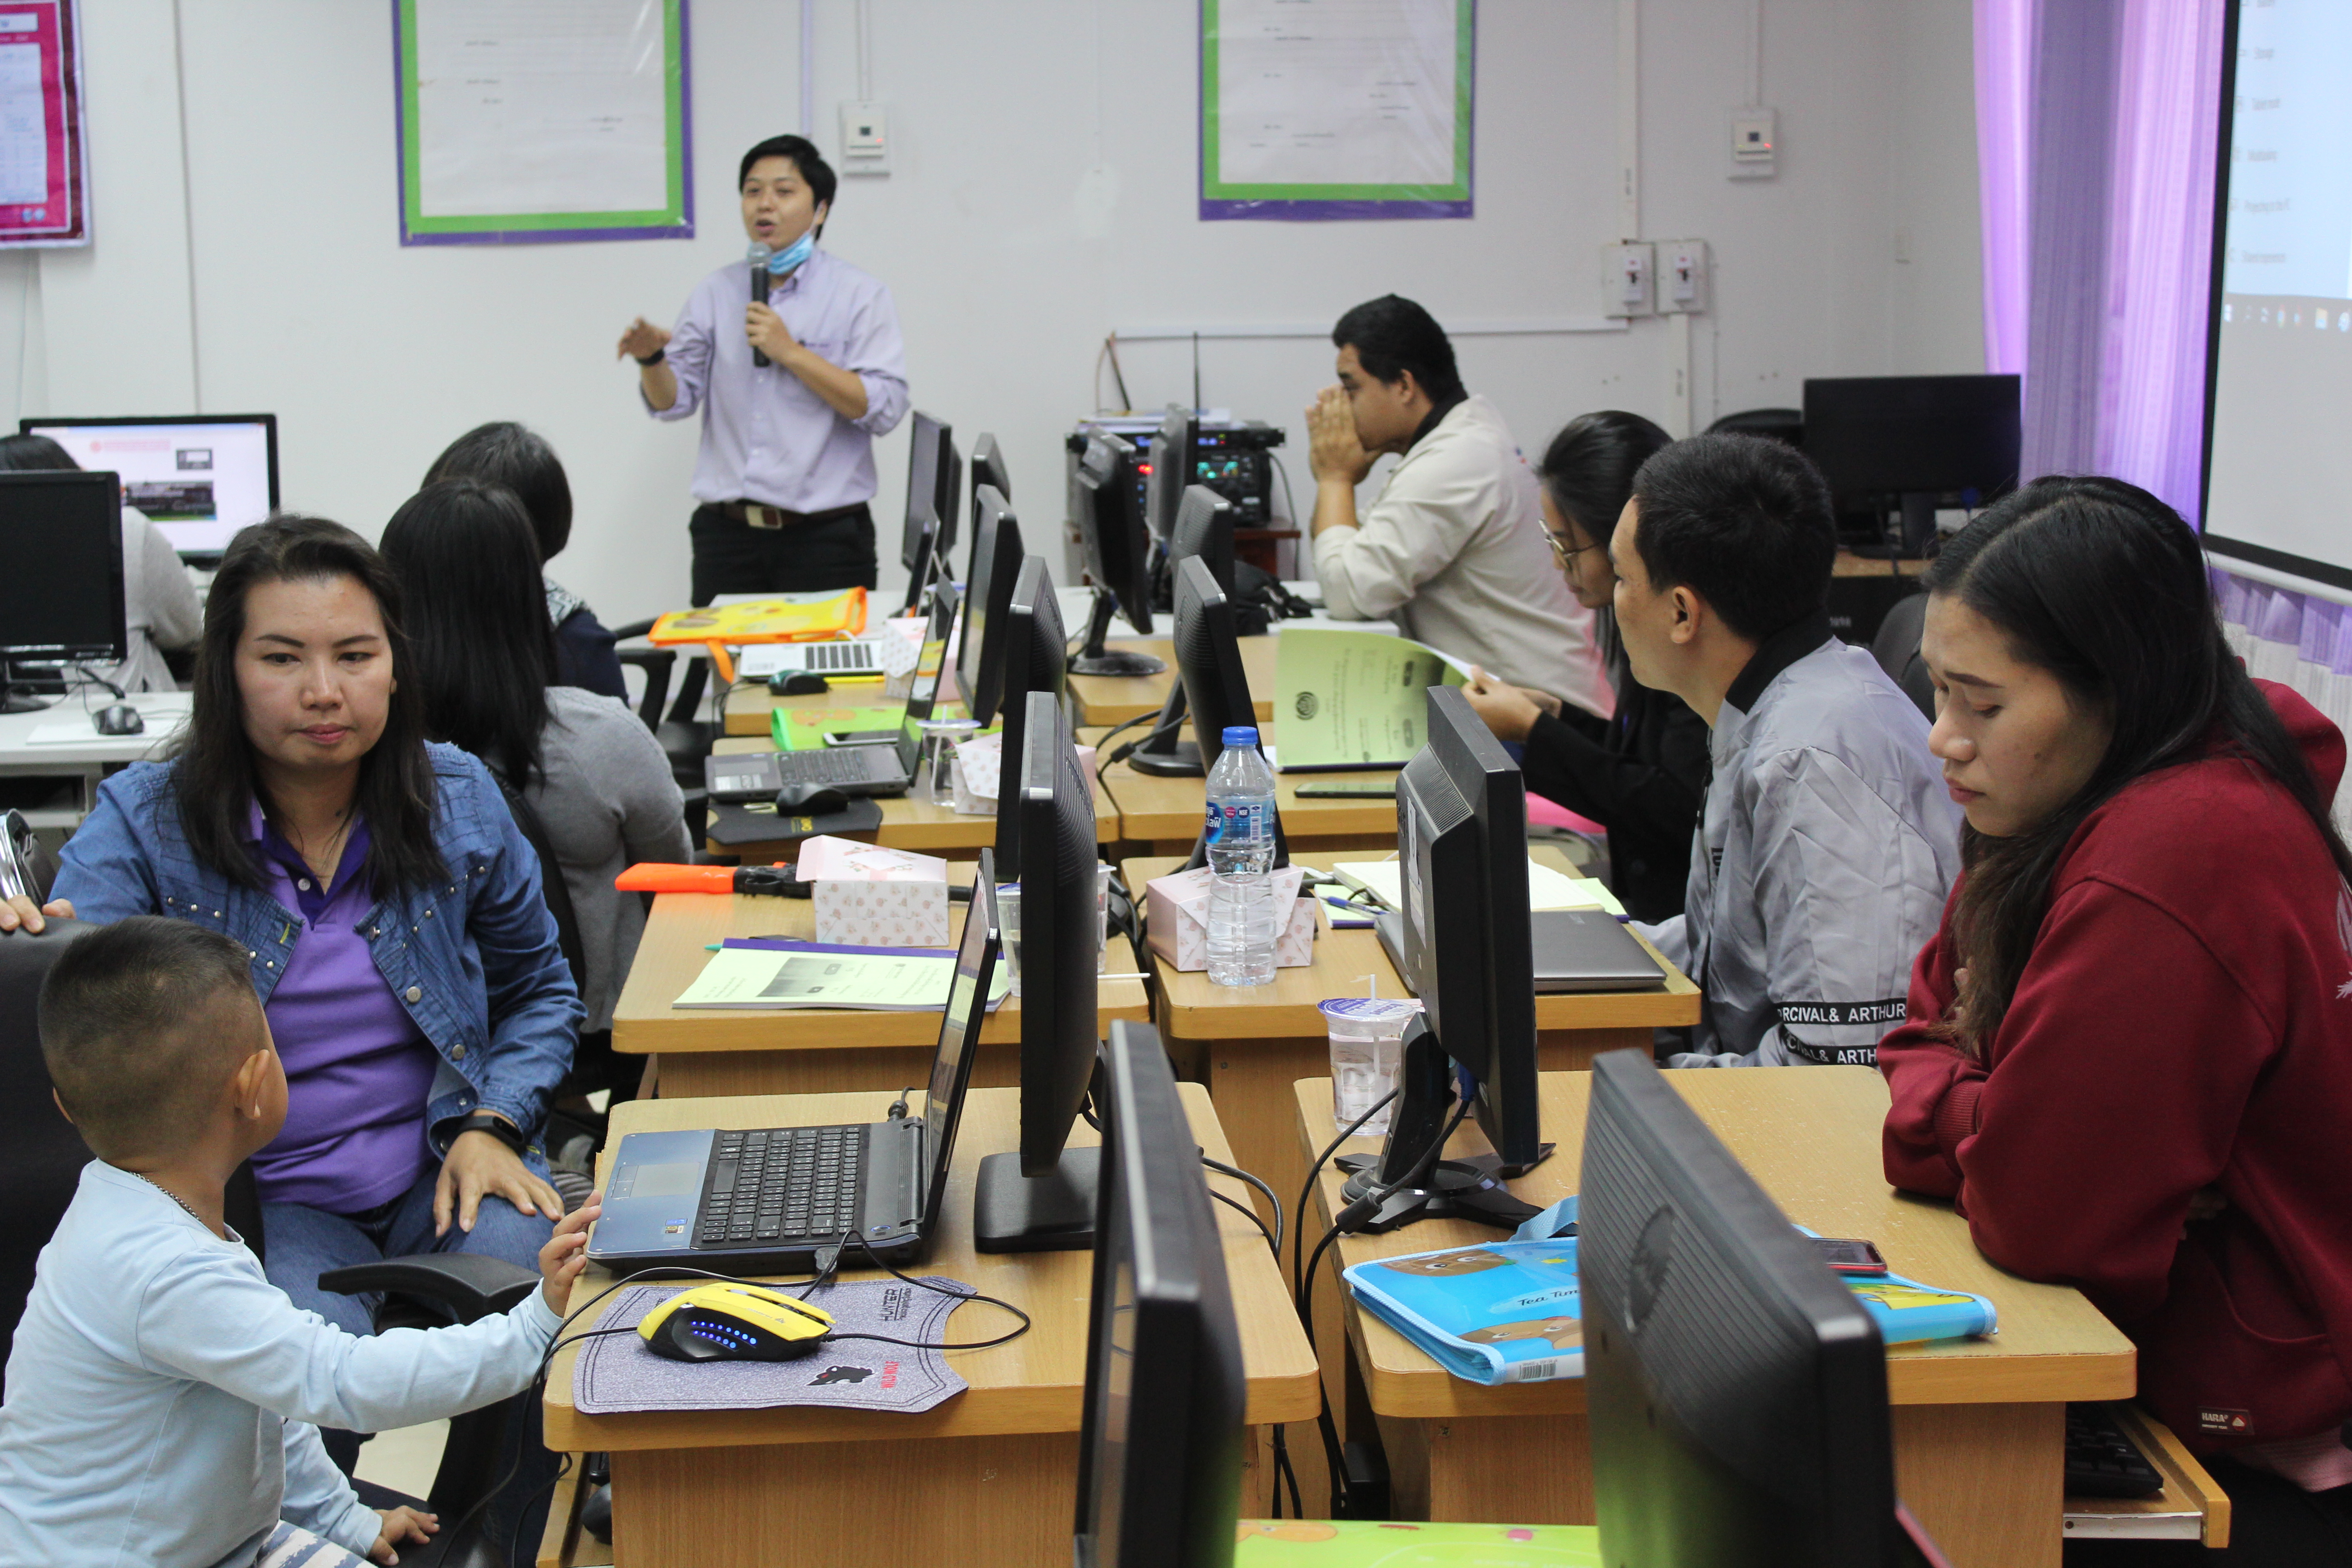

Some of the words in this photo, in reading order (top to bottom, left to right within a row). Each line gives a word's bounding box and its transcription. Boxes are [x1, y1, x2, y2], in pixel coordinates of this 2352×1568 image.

[1848, 1003, 1906, 1022] ARTHUR
[878, 1289, 897, 1321] HUNTER
[1517, 1297, 1548, 1306] Tea
[883, 1361, 899, 1375] WOLF
[880, 1376, 896, 1388] WILD
